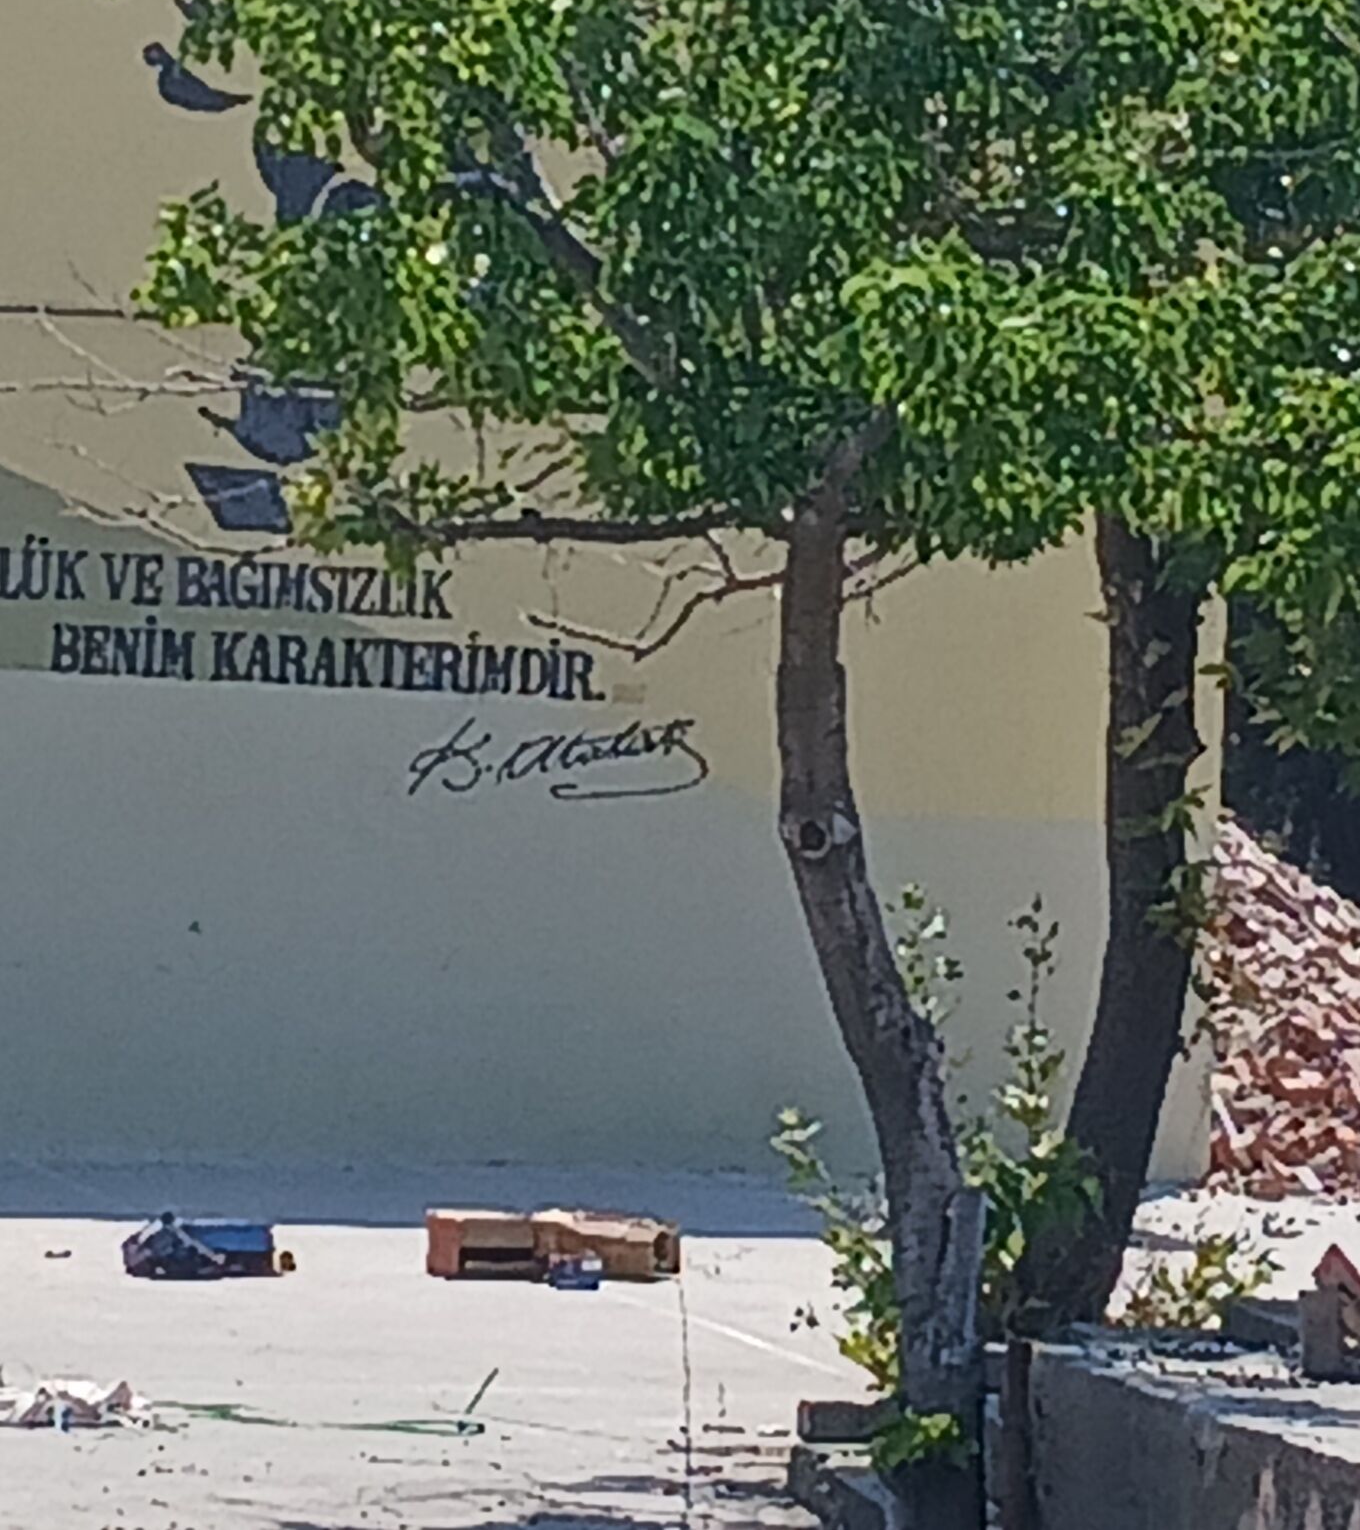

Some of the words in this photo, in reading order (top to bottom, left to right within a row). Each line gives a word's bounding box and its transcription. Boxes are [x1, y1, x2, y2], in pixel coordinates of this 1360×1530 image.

[100, 552, 164, 607] VE
[50, 615, 196, 681] BENİM
[209, 630, 606, 701] KARAKTERİMDİR.
